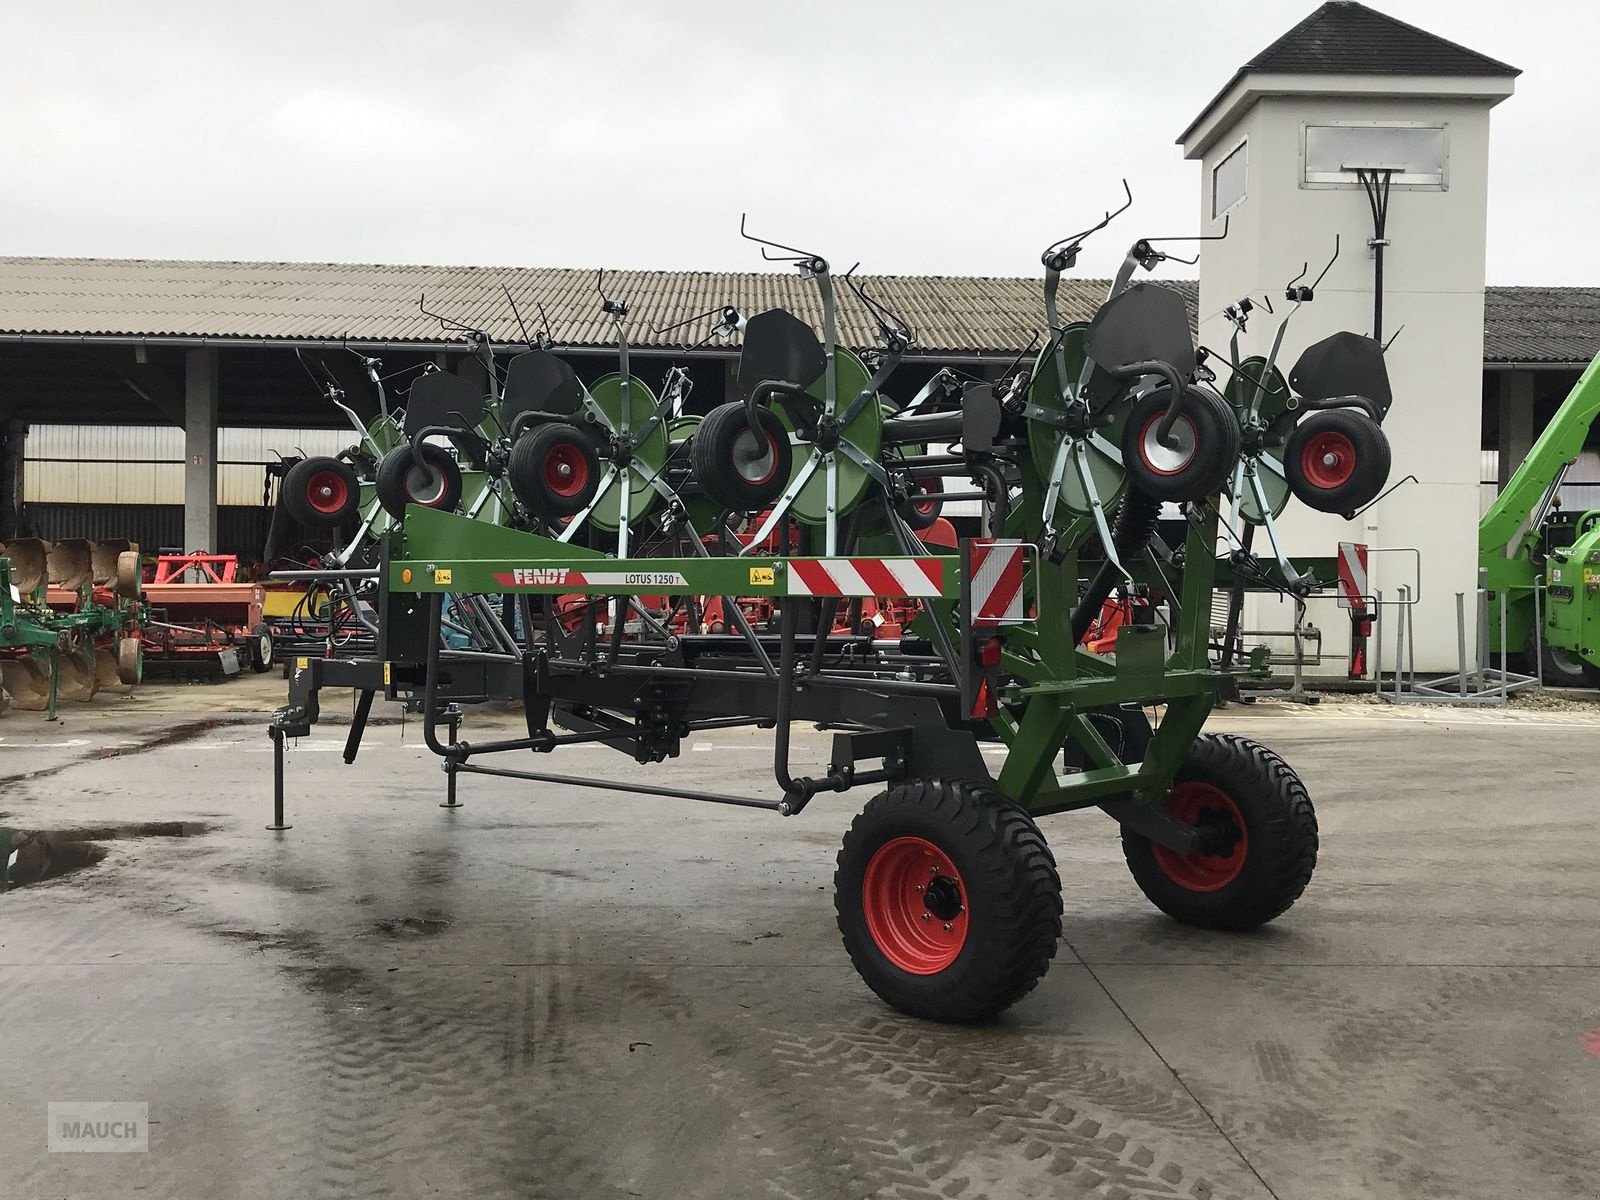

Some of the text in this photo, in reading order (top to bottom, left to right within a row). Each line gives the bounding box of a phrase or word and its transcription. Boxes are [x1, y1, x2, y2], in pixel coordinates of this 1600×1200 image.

[512, 567, 570, 585] FENDT
[625, 574, 680, 585] LOTUS 1250 T
